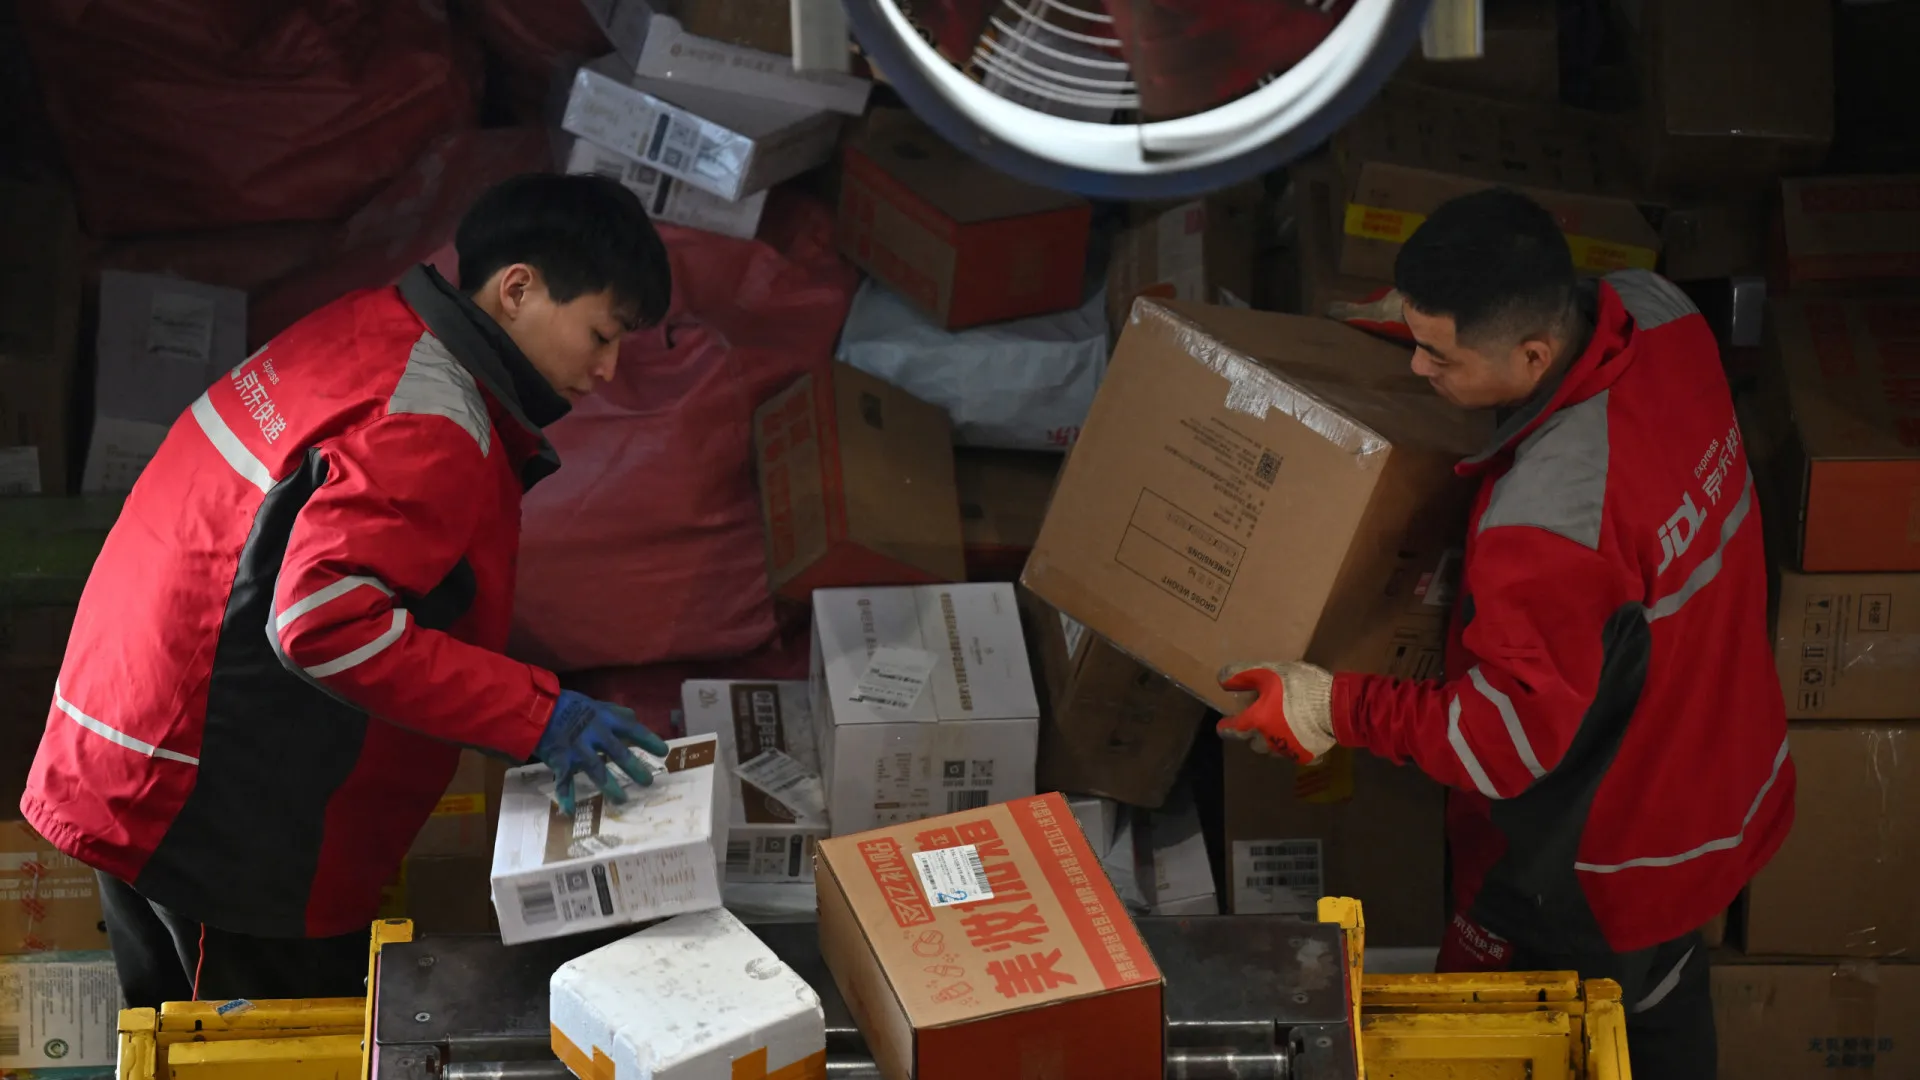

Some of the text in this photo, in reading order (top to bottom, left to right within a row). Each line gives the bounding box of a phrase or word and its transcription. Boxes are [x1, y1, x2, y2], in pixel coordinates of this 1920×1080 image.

[262, 358, 280, 385] Express
[234, 370, 287, 444] 京东快递
[1693, 439, 1719, 480] Express
[1657, 490, 1708, 577] JDL
[1187, 546, 1231, 578] DIMENSIONS
[1161, 575, 1217, 613] GROSS WEIGHT
[1453, 914, 1507, 961] 京东快递
